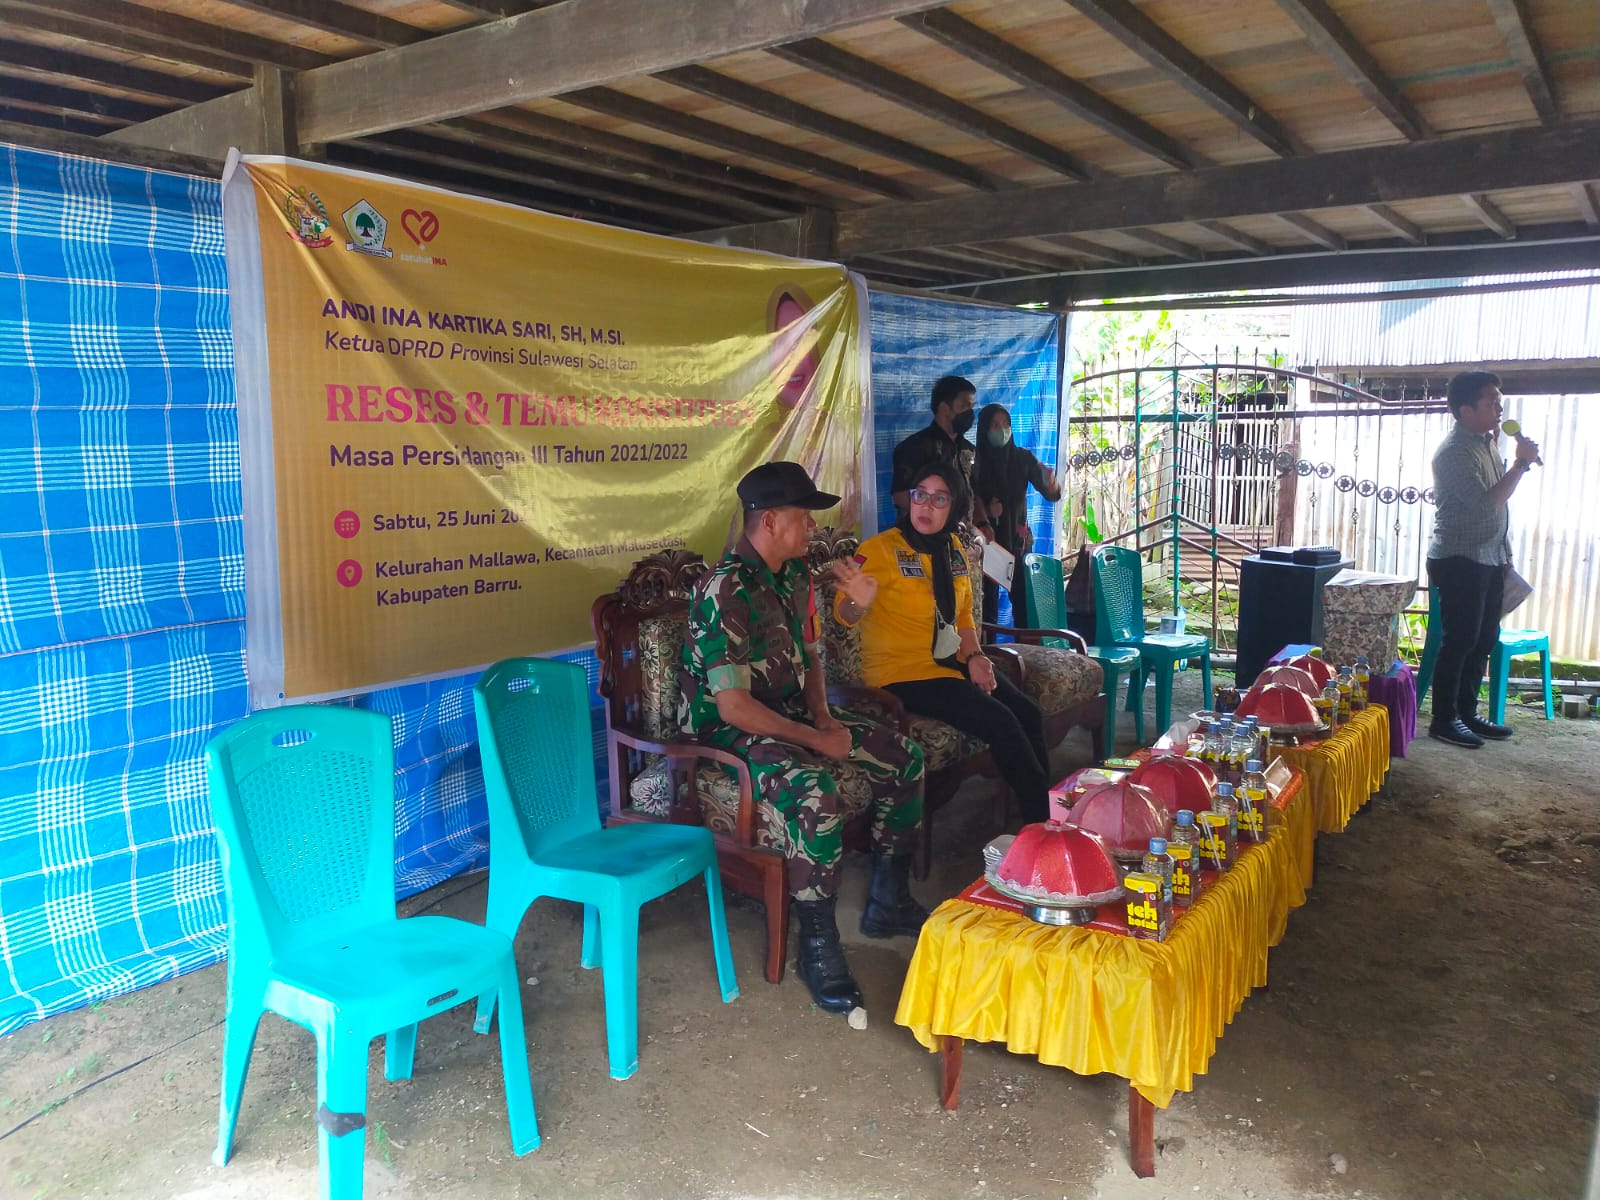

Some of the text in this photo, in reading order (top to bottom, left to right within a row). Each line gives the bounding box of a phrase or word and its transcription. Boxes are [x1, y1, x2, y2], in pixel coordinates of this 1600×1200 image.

[322, 298, 625, 346] ANDI INA KARTIKA SARI, SH, M.SI.
[325, 330, 638, 371] Ketua DPRD Provinsi Sulawesi Selatan
[325, 384, 457, 425] RESES
[464, 391, 490, 426] &
[496, 392, 588, 427] TEMU
[330, 443, 688, 470] Masa Persidangan III Tahun 2021/2022
[373, 514, 431, 531] Sabtu,
[437, 510, 458, 527] 25
[463, 509, 496, 526] Juni
[376, 557, 464, 578] Kelurahan
[469, 552, 540, 569] Mallawa,
[545, 543, 614, 561] Kecamatan
[376, 579, 521, 607] Kabupaten Barru.
[1127, 900, 1157, 921] teh
